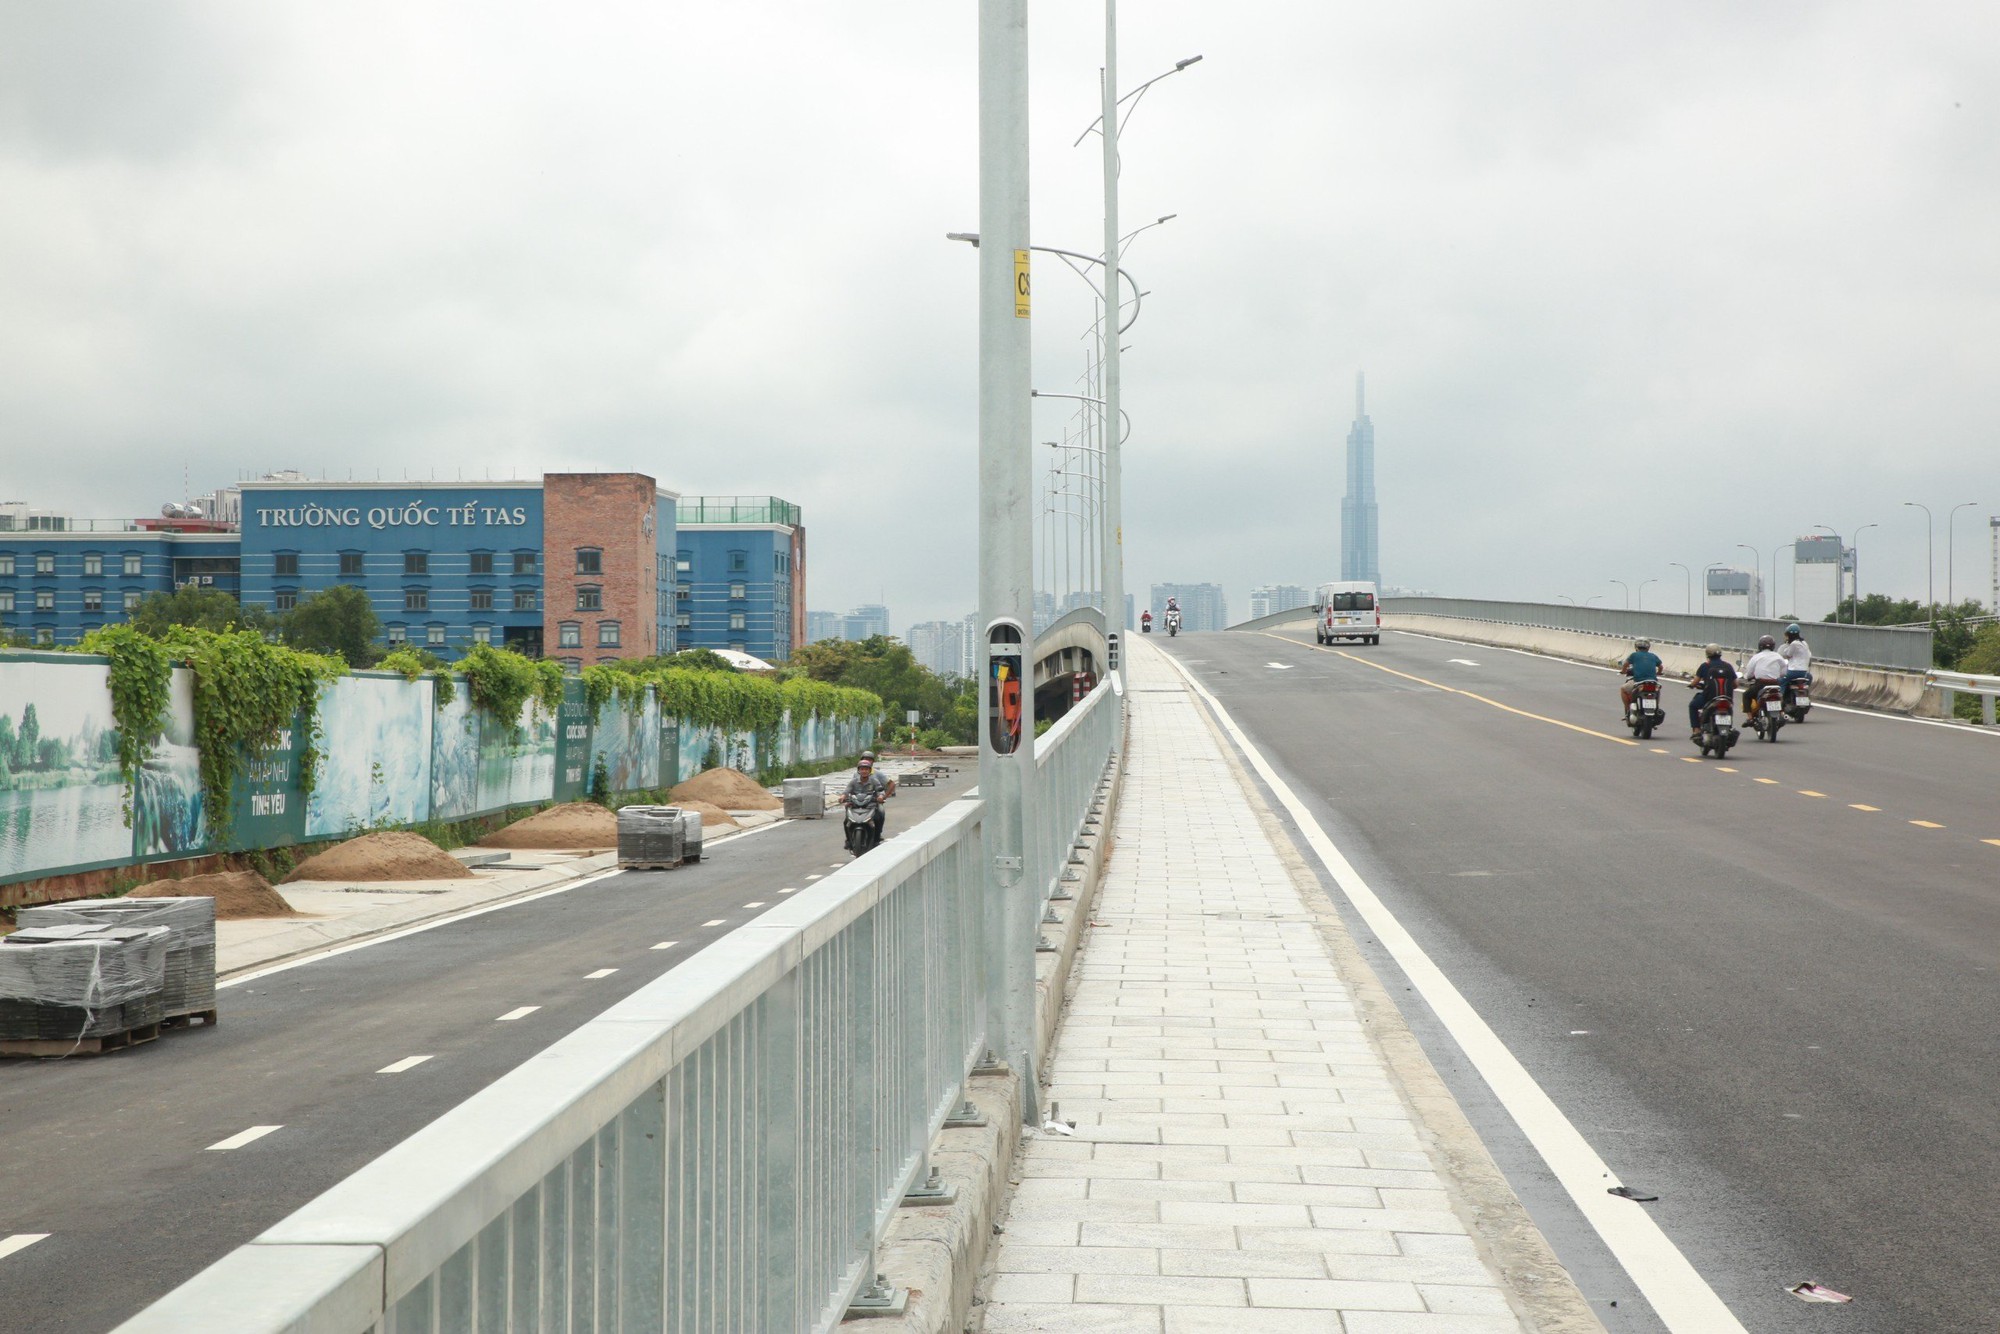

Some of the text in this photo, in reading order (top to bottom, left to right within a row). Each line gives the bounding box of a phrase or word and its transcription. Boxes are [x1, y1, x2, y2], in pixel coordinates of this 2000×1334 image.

[257, 500, 526, 530] TRƯỜNG QUỐC TẾ TAS
[272, 758, 290, 782] NHƯ
[251, 788, 286, 816] TÌNH YÊU
